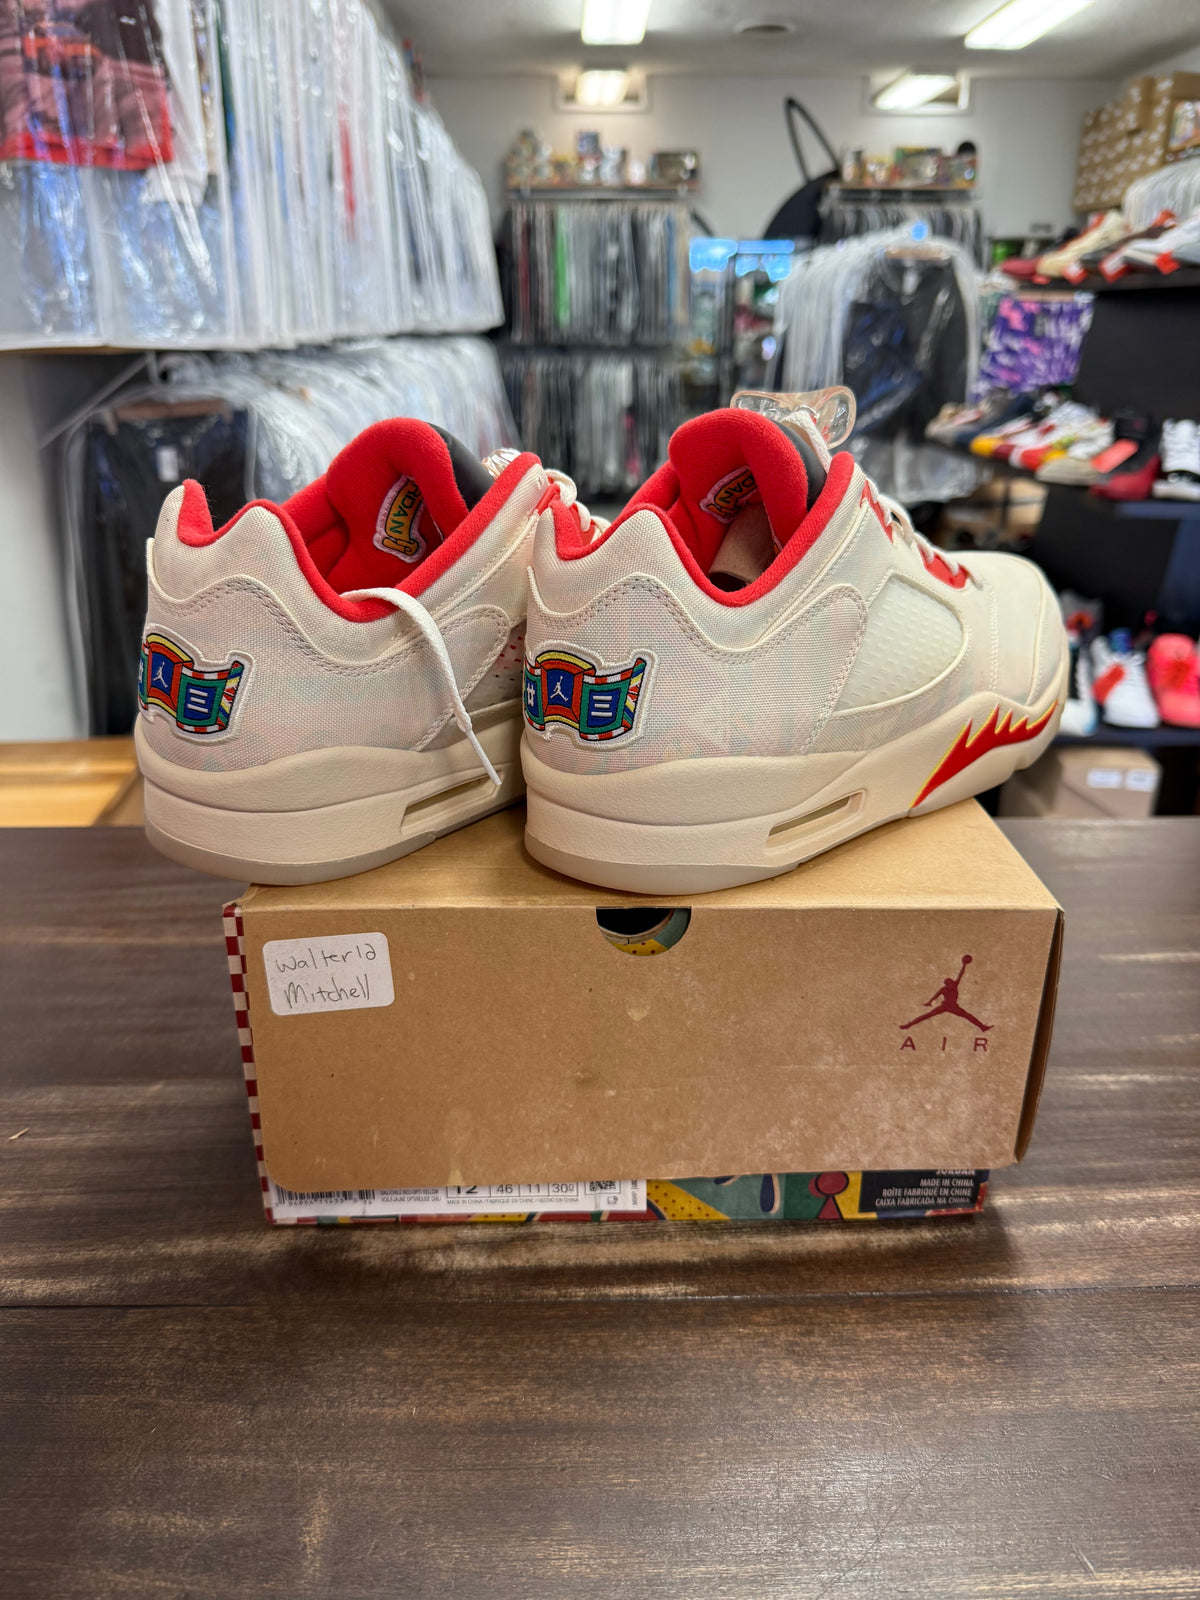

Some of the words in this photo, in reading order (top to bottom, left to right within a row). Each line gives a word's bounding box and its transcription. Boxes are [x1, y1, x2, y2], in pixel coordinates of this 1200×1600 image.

[284, 973, 370, 1009] Mitchell
[899, 1036, 989, 1052] AIR
[919, 1178, 940, 1187] MADE
[941, 1178, 950, 1187] IN
[951, 1178, 974, 1187] CHINA
[496, 1184, 513, 1194] 46
[527, 1183, 541, 1193] 11
[939, 1187, 949, 1196] EN
[950, 1187, 972, 1196] CHINE
[875, 1198, 896, 1207] CAIXA
[897, 1197, 935, 1206] FABRICADA
